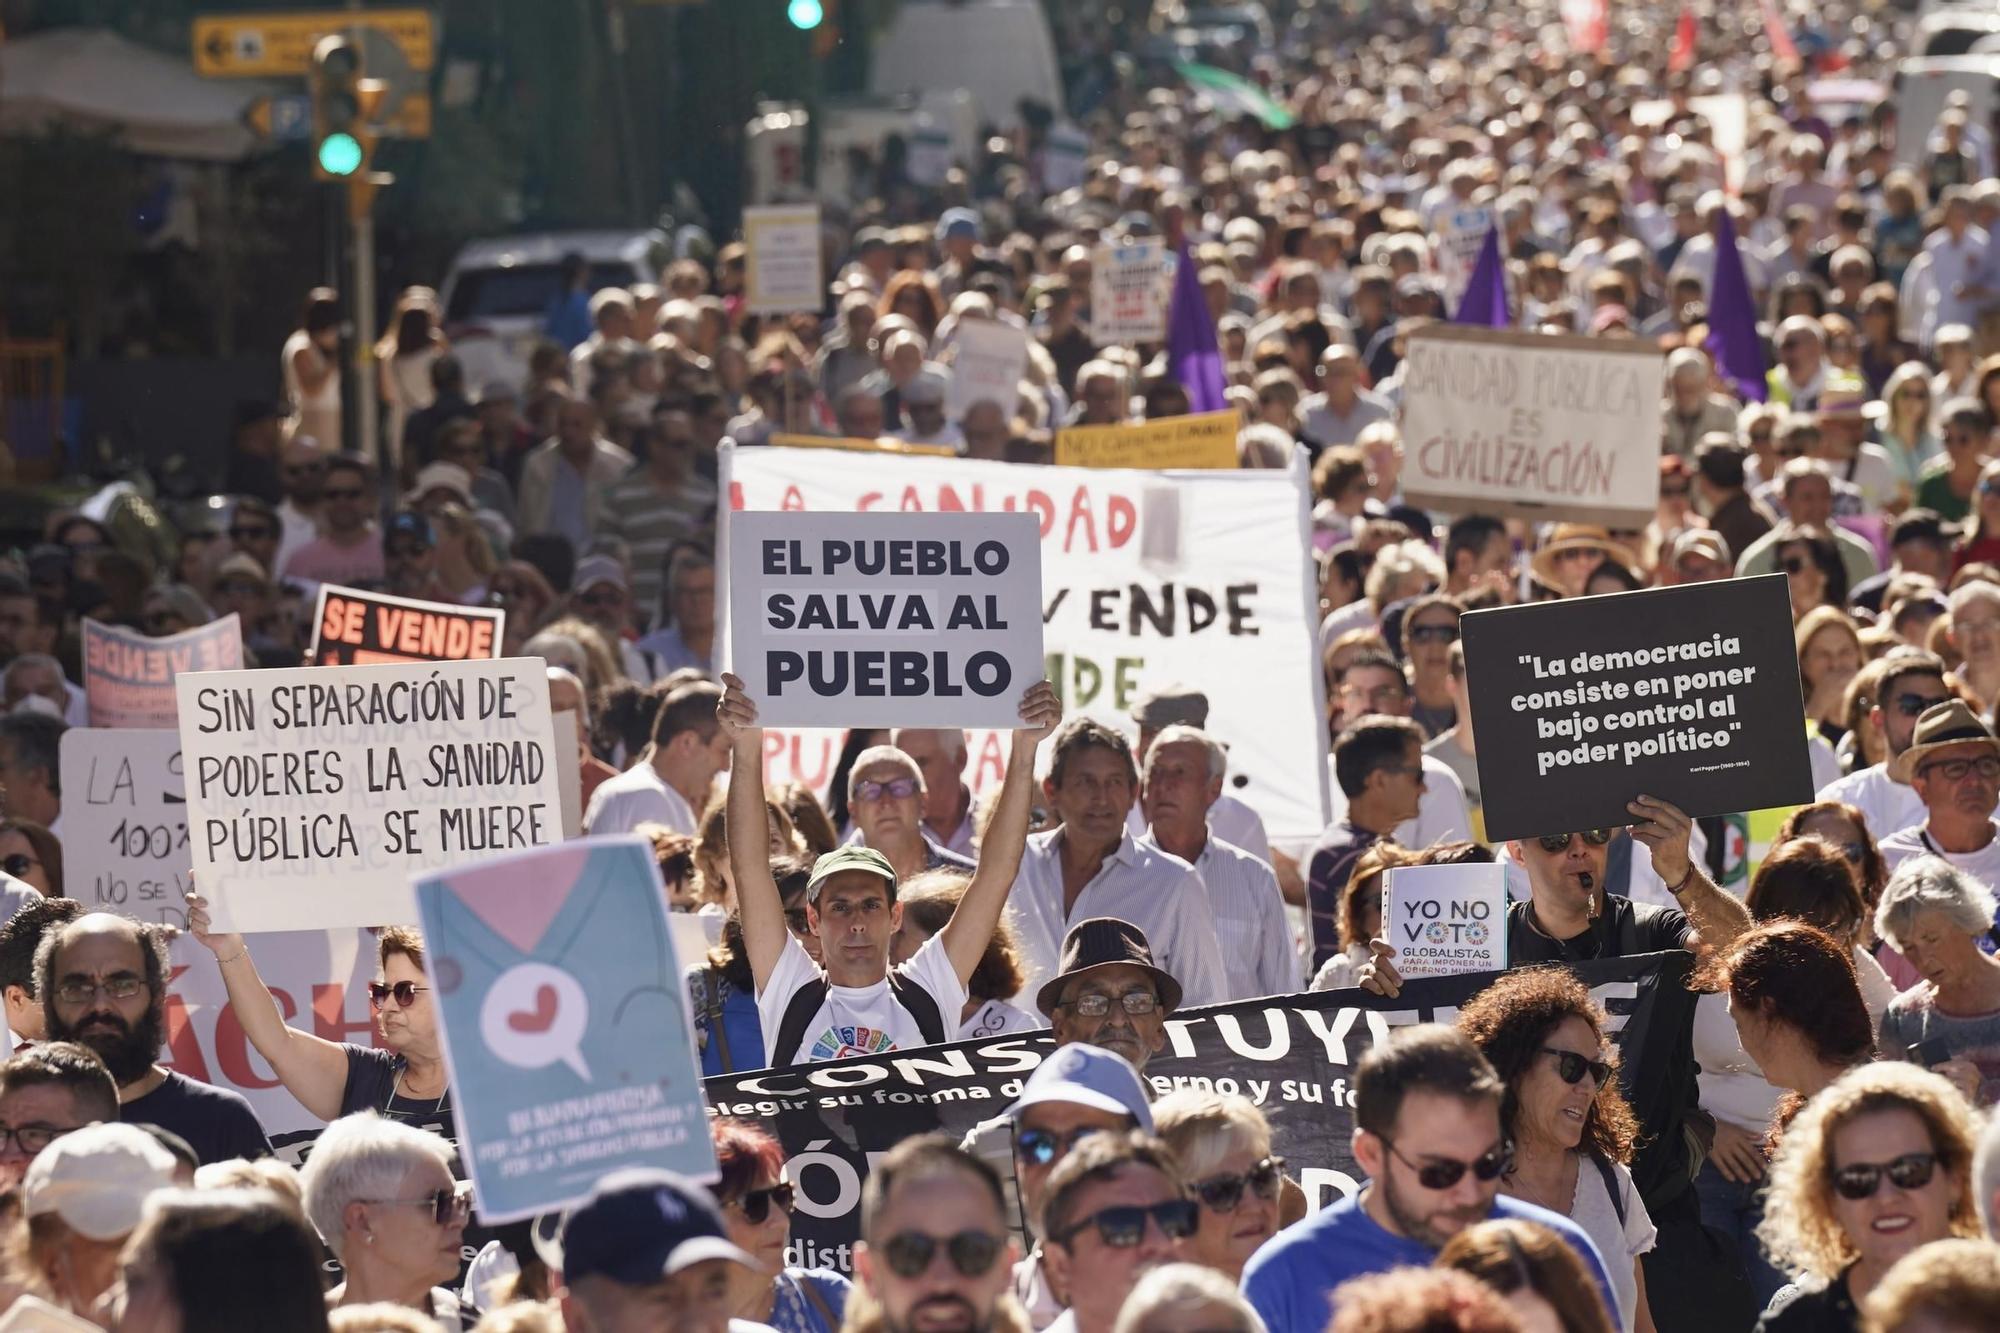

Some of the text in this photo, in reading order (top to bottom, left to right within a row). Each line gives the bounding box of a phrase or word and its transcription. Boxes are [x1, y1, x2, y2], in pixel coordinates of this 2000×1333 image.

[1510, 406, 1543, 438] ES
[762, 540, 1010, 576] EL PUEBLO
[322, 597, 494, 660] SE VENDE
[767, 594, 1008, 630] SALVA AL
[766, 650, 1012, 697] PUEBLO
[1518, 633, 1741, 679] "La democracia
[478, 676, 517, 721] DE
[1510, 664, 1757, 712] consiste en poner
[1536, 694, 1736, 742] bajo control al
[1536, 721, 1742, 776] poder político"
[86, 754, 136, 806] LA
[199, 750, 344, 799] PODERES
[367, 746, 407, 793] LA
[383, 809, 423, 855] SE
[439, 803, 550, 852] MUERE
[96, 871, 128, 904] NO
[138, 880, 167, 900] SE
[1404, 900, 1490, 920] YO NO
[1402, 947, 1490, 959] GLOBALISTAS
[1403, 921, 1489, 945] VOTO
[1398, 966, 1447, 974] GOBIERNO
[1432, 958, 1475, 967] IMPONER
[703, 1098, 808, 1117] elegir
[818, 1095, 864, 1109] su
[872, 1085, 991, 1105] forma
[1000, 1078, 1024, 1098] d
[1150, 1075, 1240, 1099] erno
[1247, 1079, 1271, 1106] y
[1281, 1078, 1323, 1104] su
